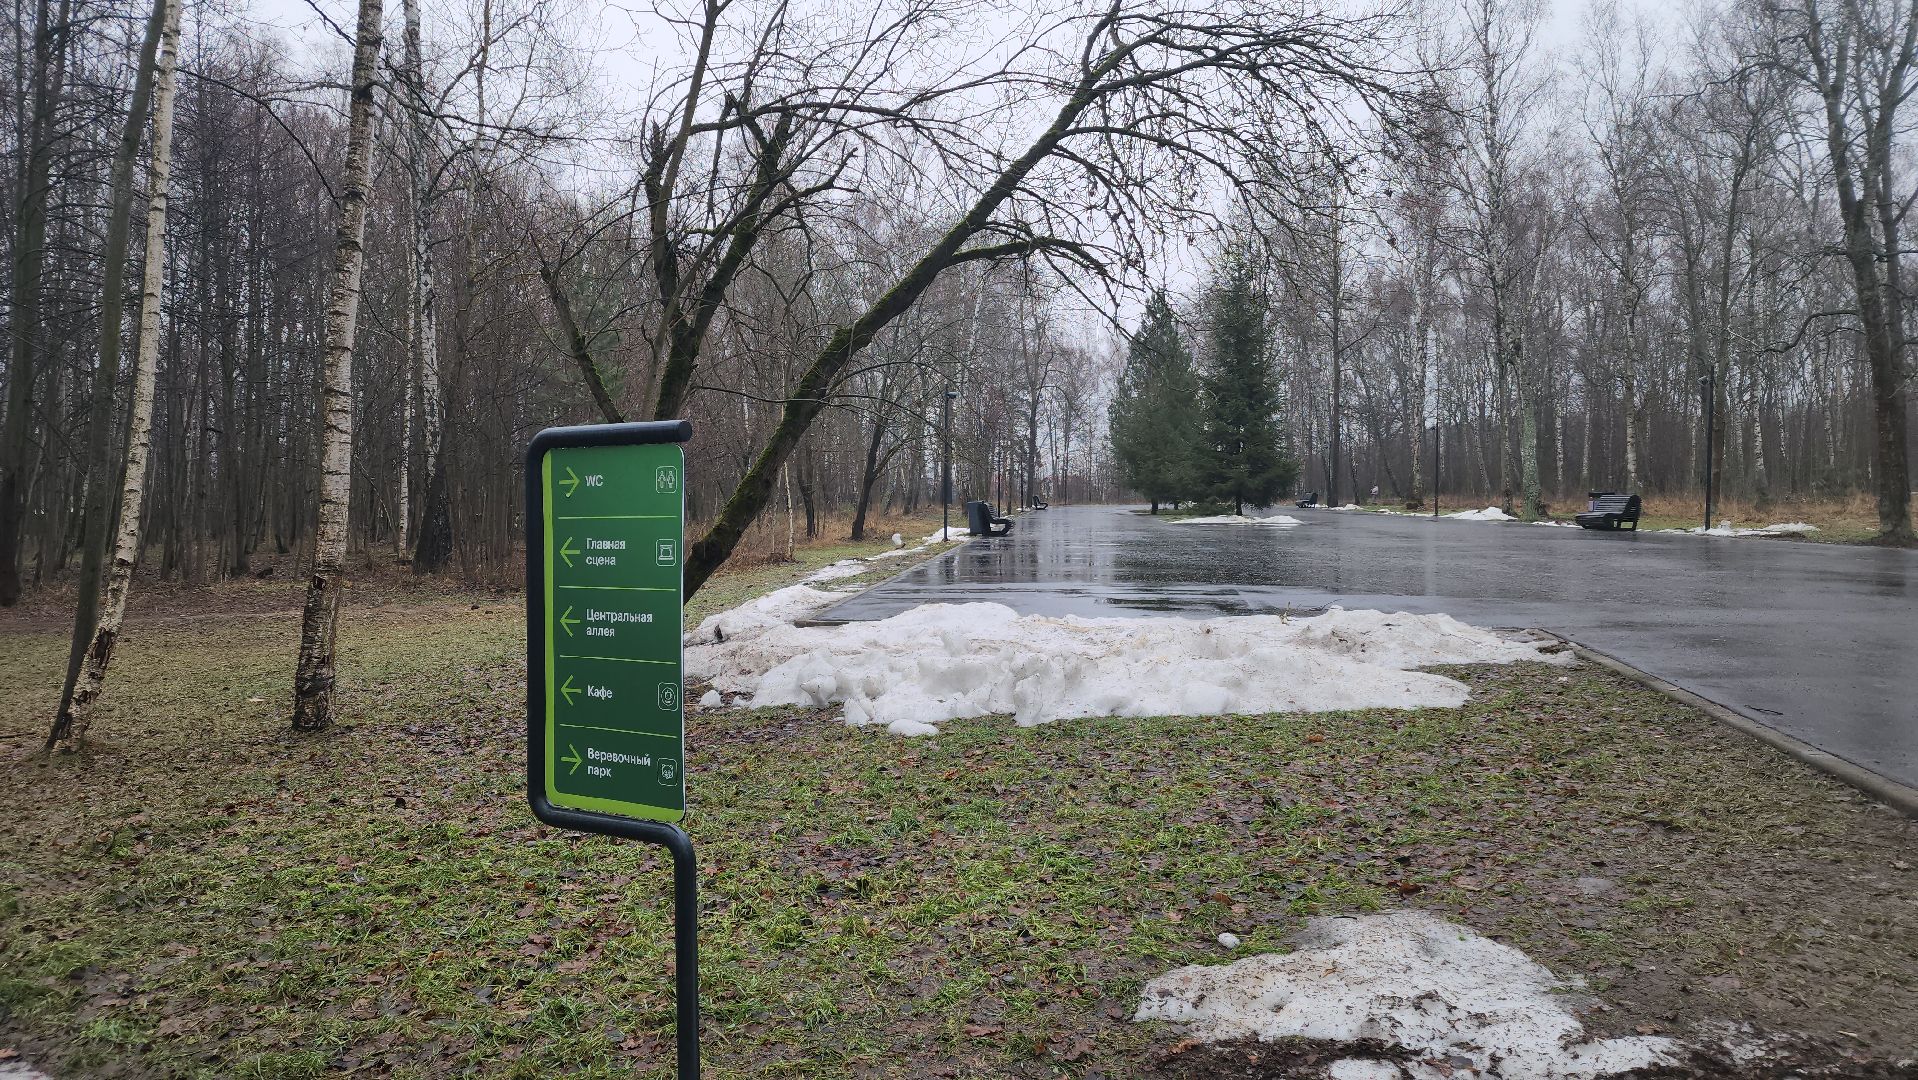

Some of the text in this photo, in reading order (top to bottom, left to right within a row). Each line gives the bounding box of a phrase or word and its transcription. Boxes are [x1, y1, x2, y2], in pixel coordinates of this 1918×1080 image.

[585, 474, 604, 487] WC
[586, 538, 626, 550] Главная
[586, 555, 616, 567] сцена
[586, 608, 653, 623] Центральная
[586, 626, 615, 637] аллея
[587, 684, 613, 701] Кафе
[587, 747, 651, 766] Веревочный
[587, 765, 612, 778] парк
